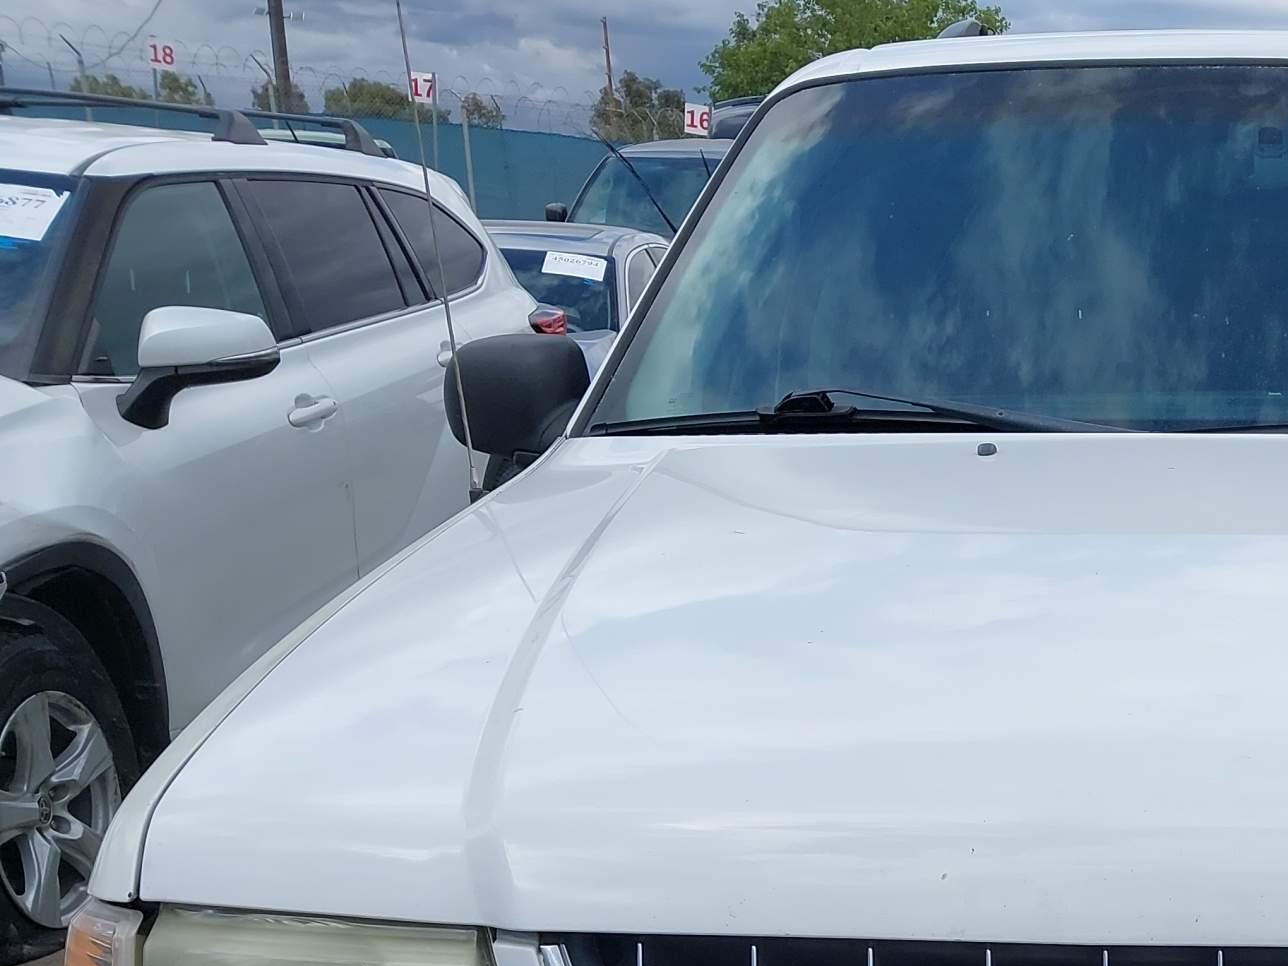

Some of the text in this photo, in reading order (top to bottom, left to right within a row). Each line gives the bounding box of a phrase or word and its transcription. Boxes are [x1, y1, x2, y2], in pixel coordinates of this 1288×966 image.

[149, 44, 174, 65] 18
[411, 78, 433, 97] 17
[686, 110, 710, 130] 16
